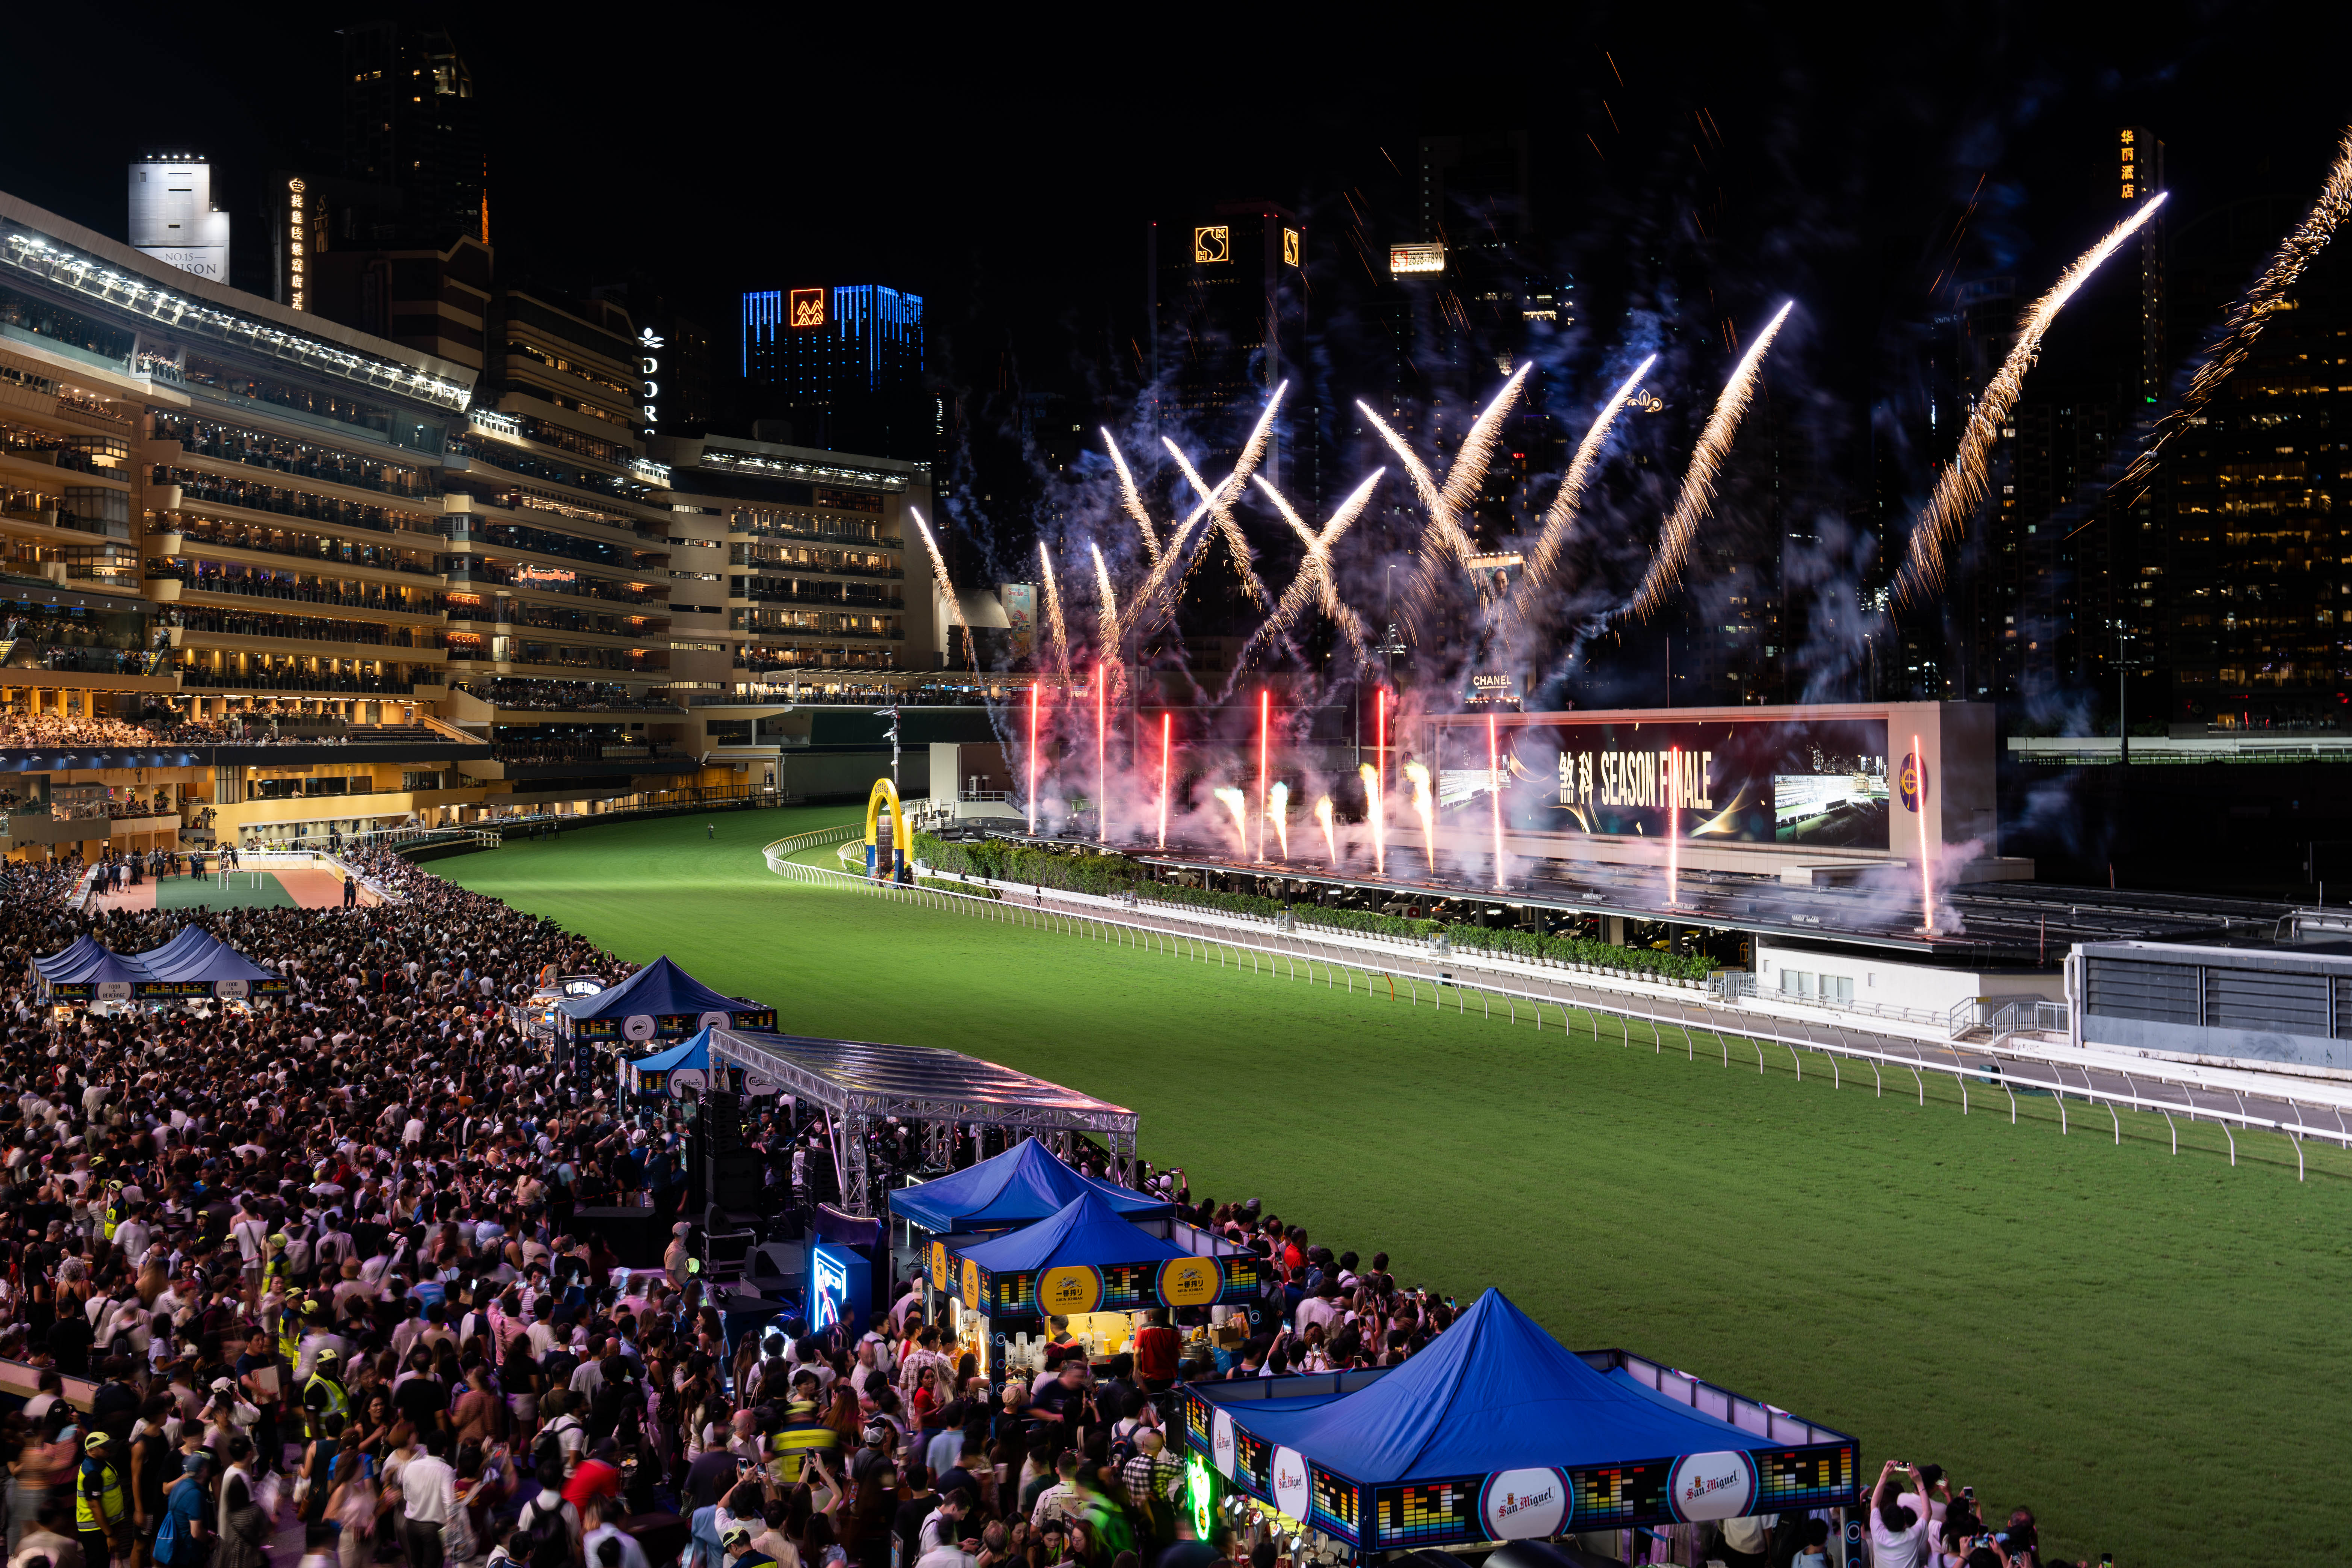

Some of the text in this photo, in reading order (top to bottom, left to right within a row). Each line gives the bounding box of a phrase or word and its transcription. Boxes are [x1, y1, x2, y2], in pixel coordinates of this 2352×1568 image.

[2121, 130, 2134, 198] 华丽酒店
[1473, 675, 1512, 686] CHANEL
[1559, 751, 1712, 809] 煞科 SEASON FINALE
[674, 1078, 702, 1089] Carlsberg
[1222, 1436, 1231, 1449] Miguel
[1278, 1474, 1302, 1489] San Miguel
[1686, 1469, 1737, 1500] San Miguel
[1499, 1485, 1551, 1518] San Miguel
